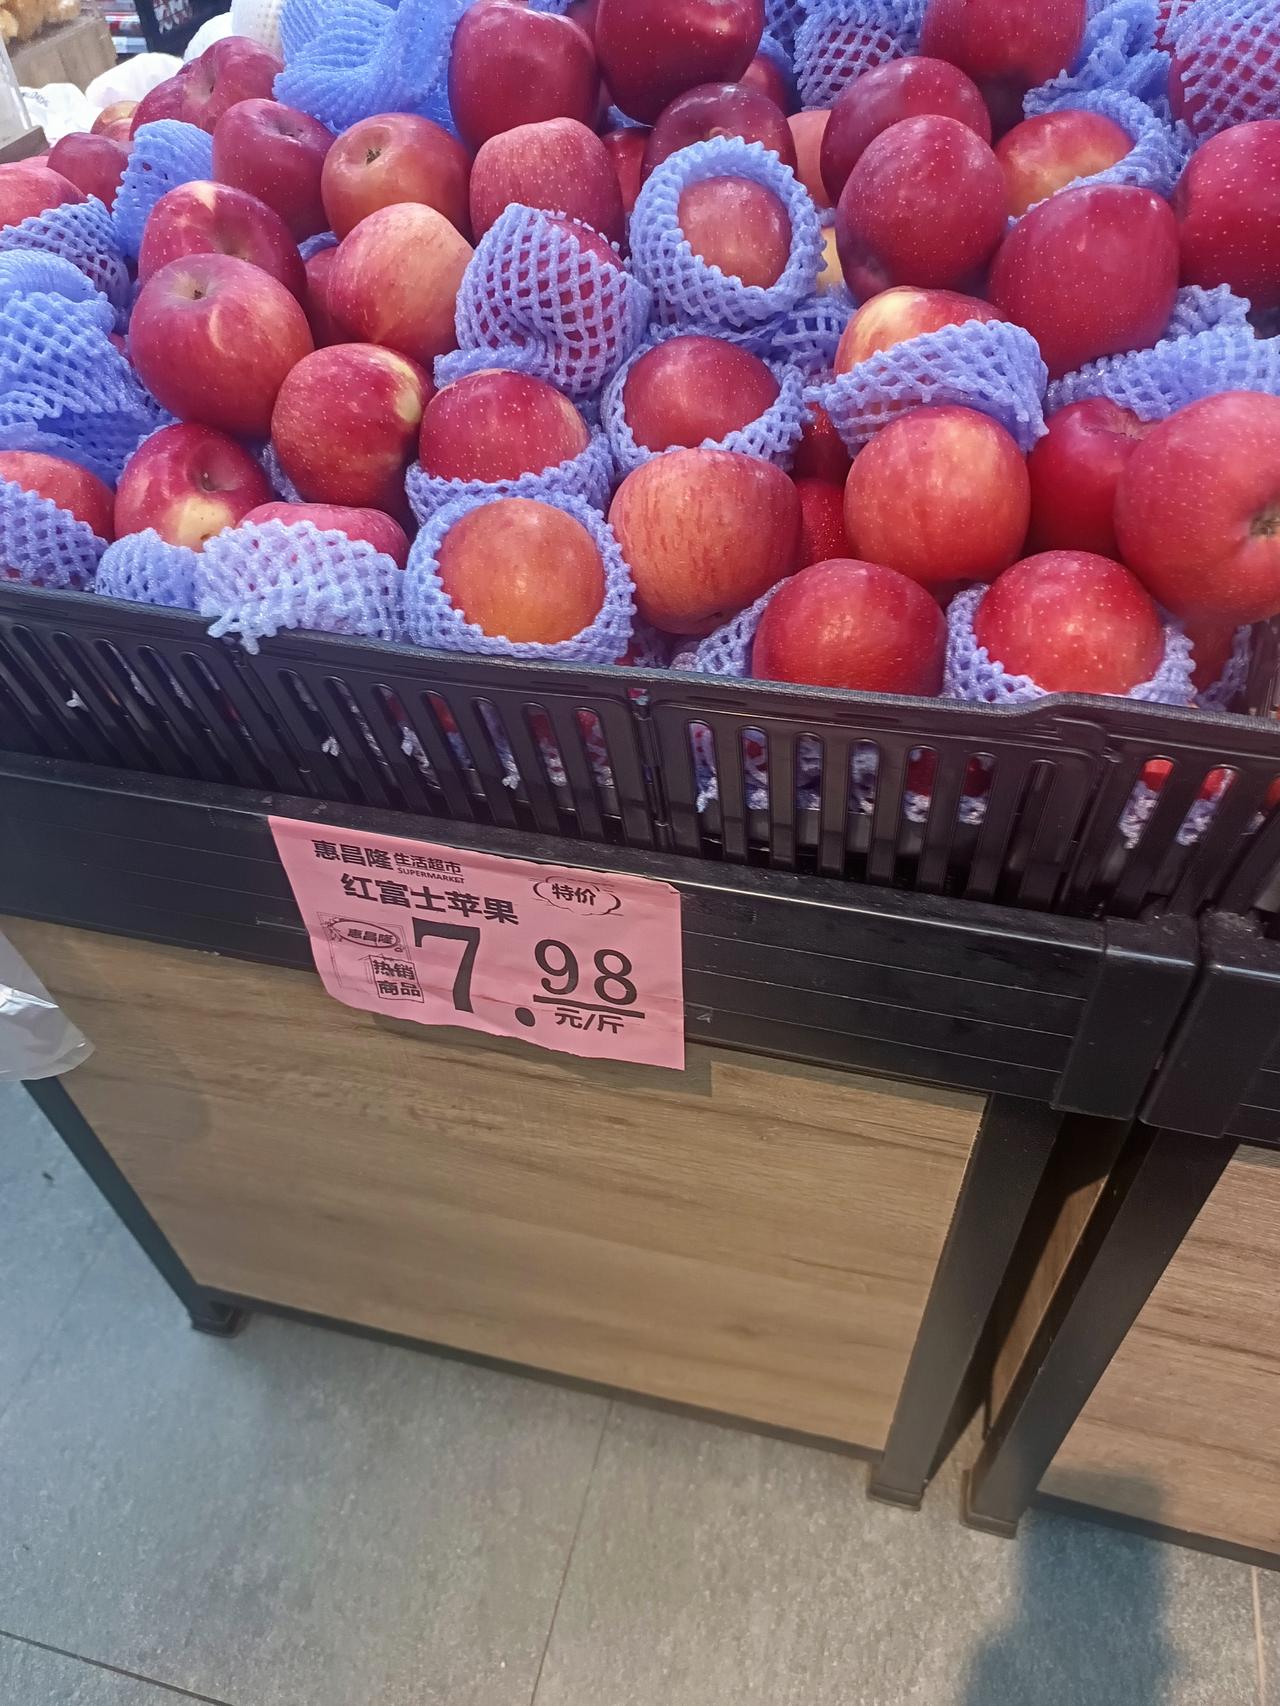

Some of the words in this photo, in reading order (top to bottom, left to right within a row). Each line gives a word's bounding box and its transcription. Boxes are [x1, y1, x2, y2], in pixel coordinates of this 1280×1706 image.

[311, 840, 394, 870] 惠昌隆
[394, 852, 462, 874] 生活超市
[396, 867, 465, 884] SUPERMARKET
[340, 873, 519, 925] 红富士苹果
[551, 883, 597, 906] 特价
[347, 928, 394, 945] 惠昌隆
[373, 960, 416, 980] 热销
[376, 980, 422, 998] 商品
[555, 1007, 625, 1034] 元/斤
